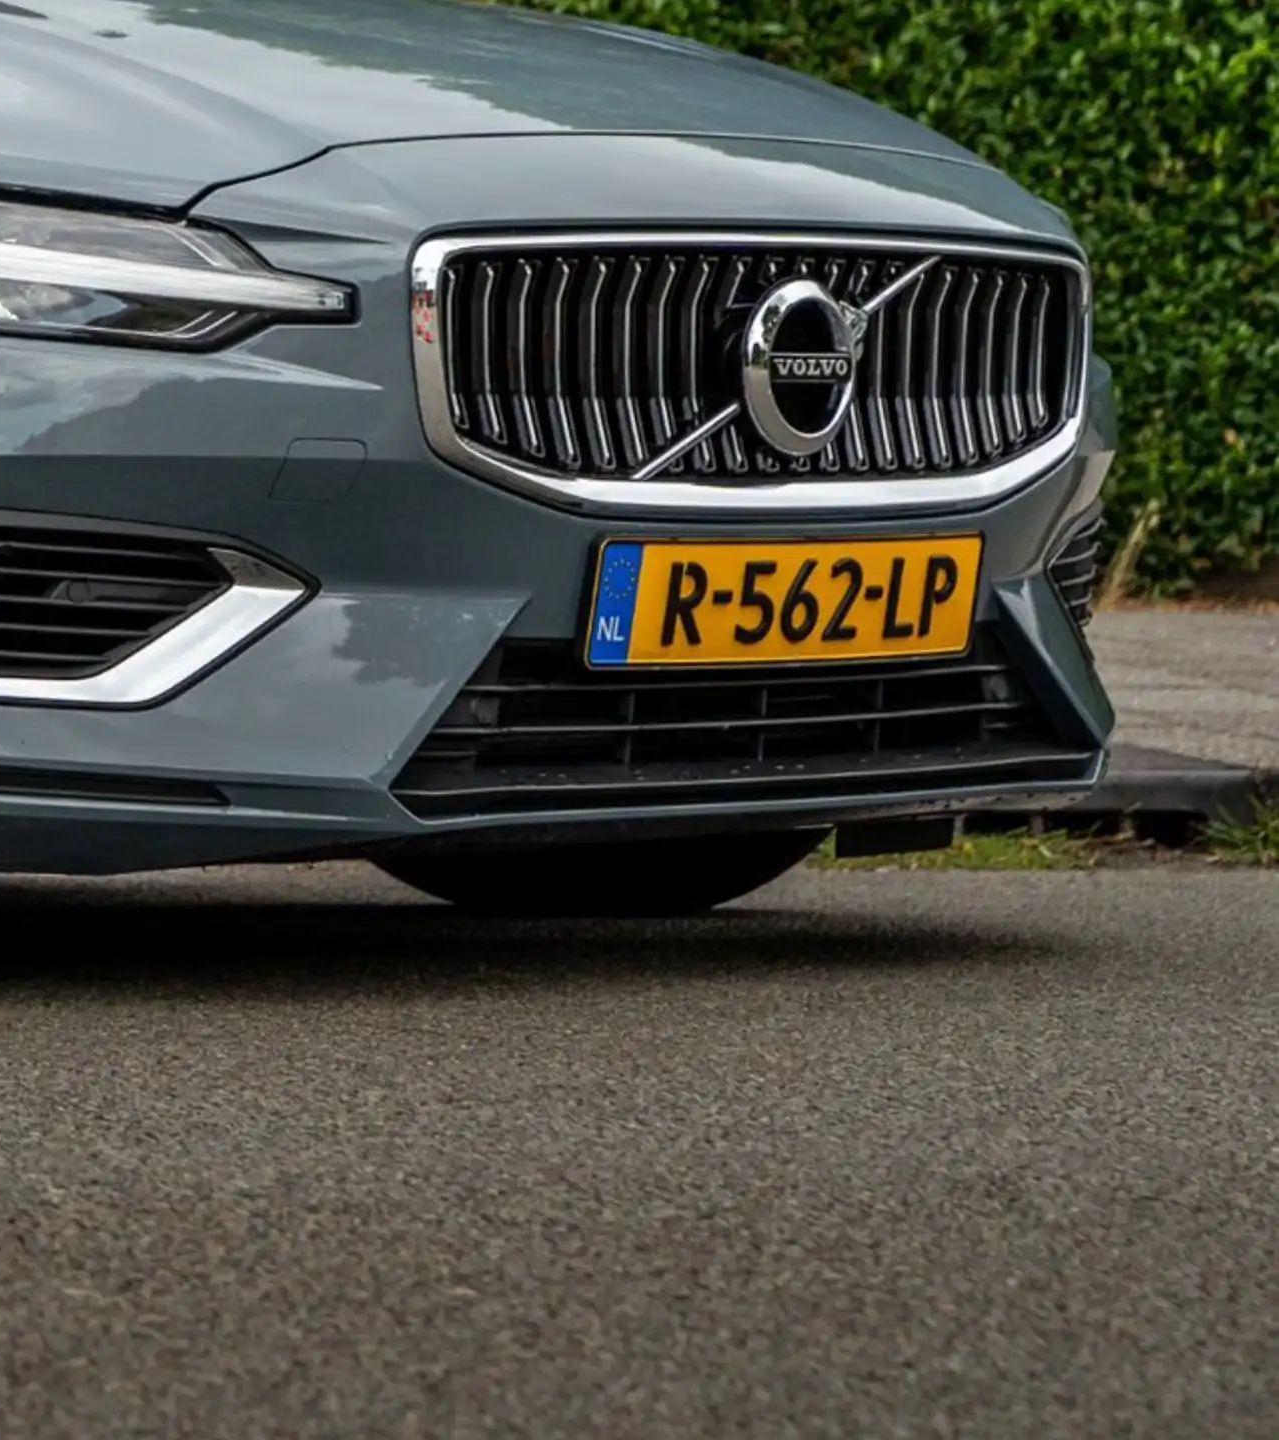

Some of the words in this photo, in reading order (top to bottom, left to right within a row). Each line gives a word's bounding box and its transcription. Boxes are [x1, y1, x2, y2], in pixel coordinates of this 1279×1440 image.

[773, 358, 848, 376] VOLVO
[660, 554, 958, 647] R-562-LP
[596, 615, 625, 642] NL
